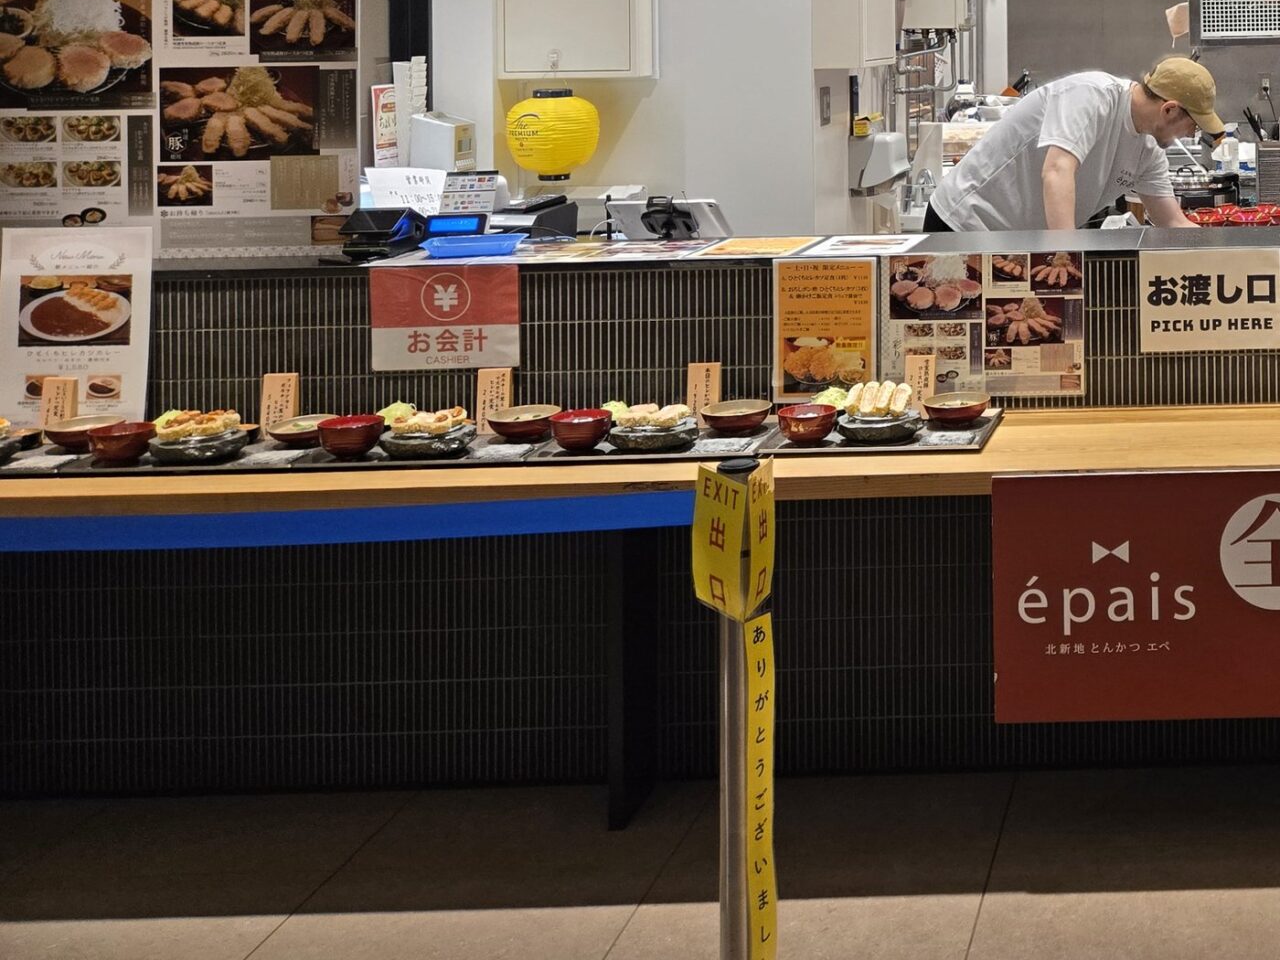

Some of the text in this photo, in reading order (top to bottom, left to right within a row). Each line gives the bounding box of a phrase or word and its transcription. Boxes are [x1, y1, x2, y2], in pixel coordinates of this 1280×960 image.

[168, 136, 185, 151] 豚
[1147, 274, 1276, 307] お渡し口
[407, 328, 489, 354] お会計
[1151, 318, 1273, 332] PICK UP HERE
[425, 355, 471, 365] CASHIER
[703, 476, 740, 510] EXIT
[709, 516, 726, 606] 出口
[755, 508, 768, 601] 出口
[1017, 572, 1197, 636] épais
[1044, 641, 1171, 655] 北新地 とんかつ エペ
[752, 625, 772, 960] ありがとうございまし
